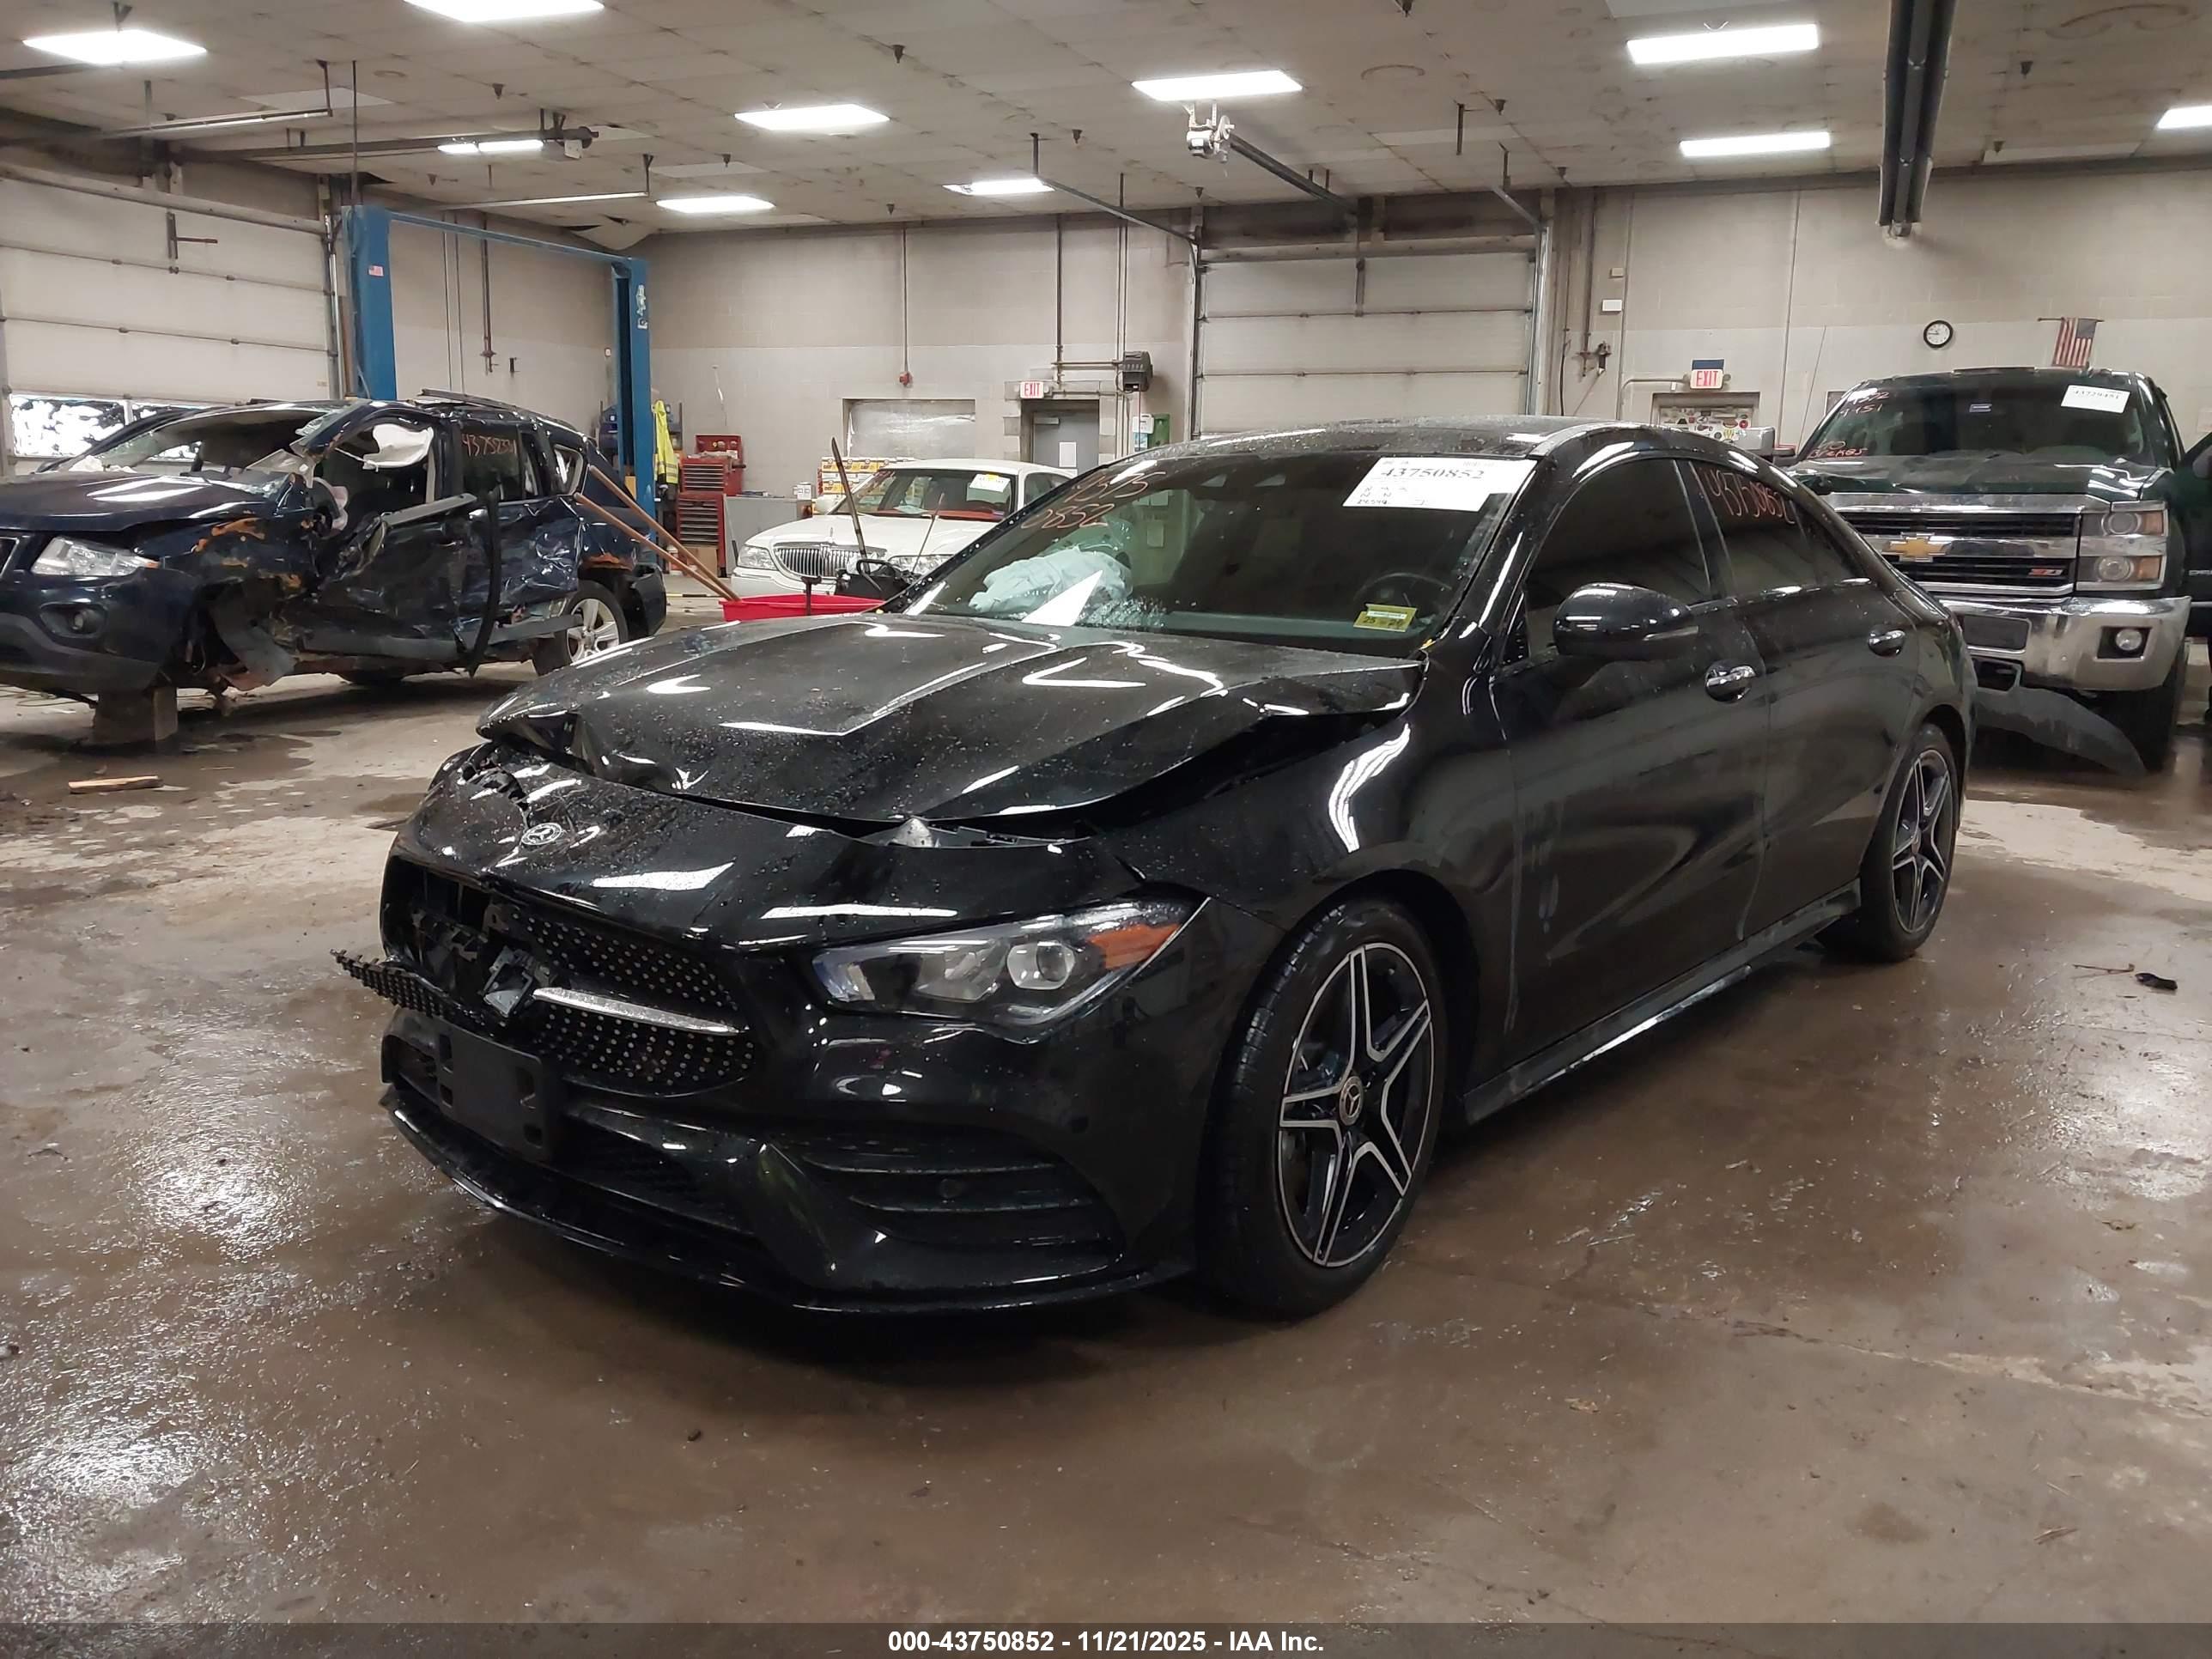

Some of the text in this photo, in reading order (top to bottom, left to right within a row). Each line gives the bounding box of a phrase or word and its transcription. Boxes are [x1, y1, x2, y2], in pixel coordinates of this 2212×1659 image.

[1695, 370, 1718, 387] EXIT
[1024, 382, 1041, 397] EXIT
[1381, 467, 1485, 479] 43750852
[1703, 469, 1796, 525] 43750852
